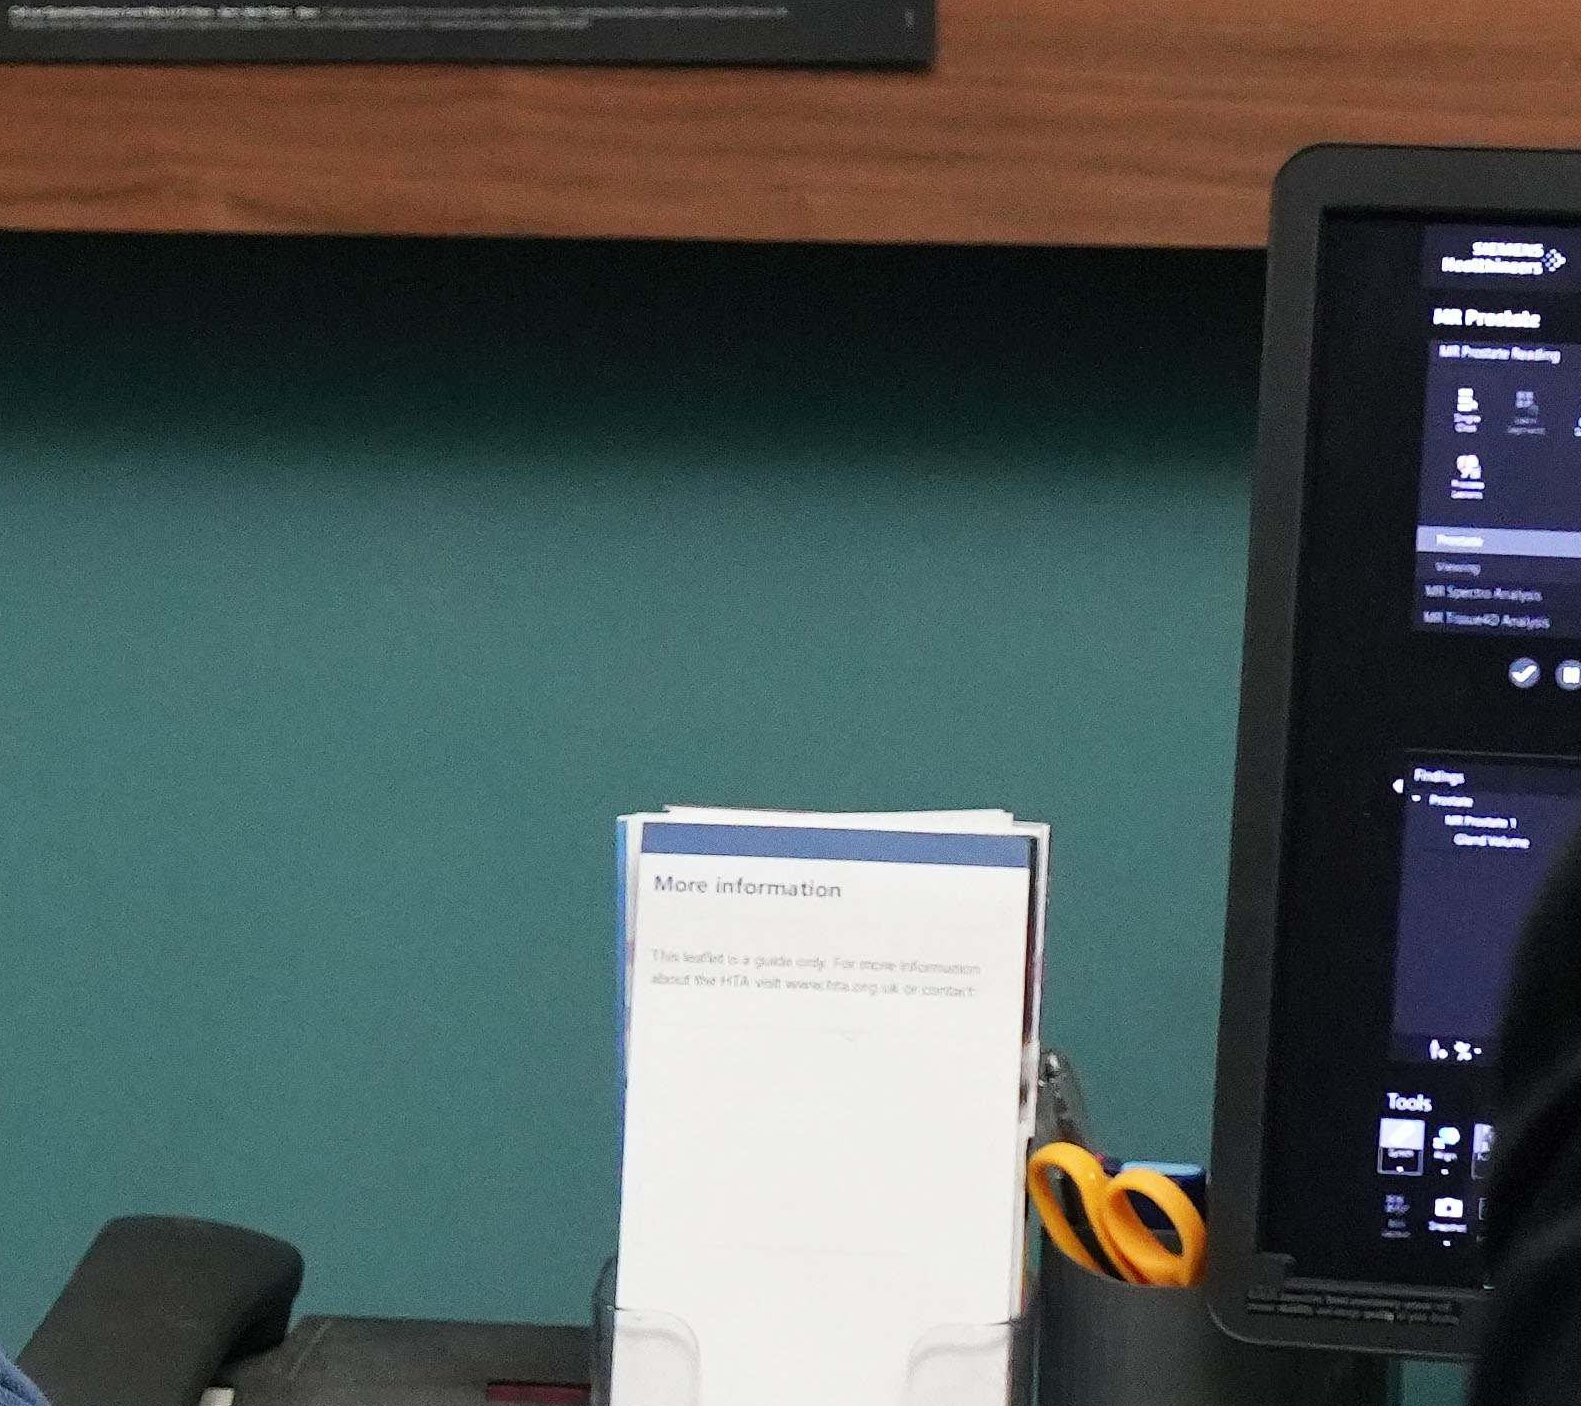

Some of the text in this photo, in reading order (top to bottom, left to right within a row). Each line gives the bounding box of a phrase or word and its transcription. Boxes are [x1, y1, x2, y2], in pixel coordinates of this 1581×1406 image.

[1472, 241, 1544, 258] SIEMENS
[1433, 307, 1541, 328] MR Prostate
[653, 874, 843, 900] More information
[1386, 1092, 1433, 1112] Tools
